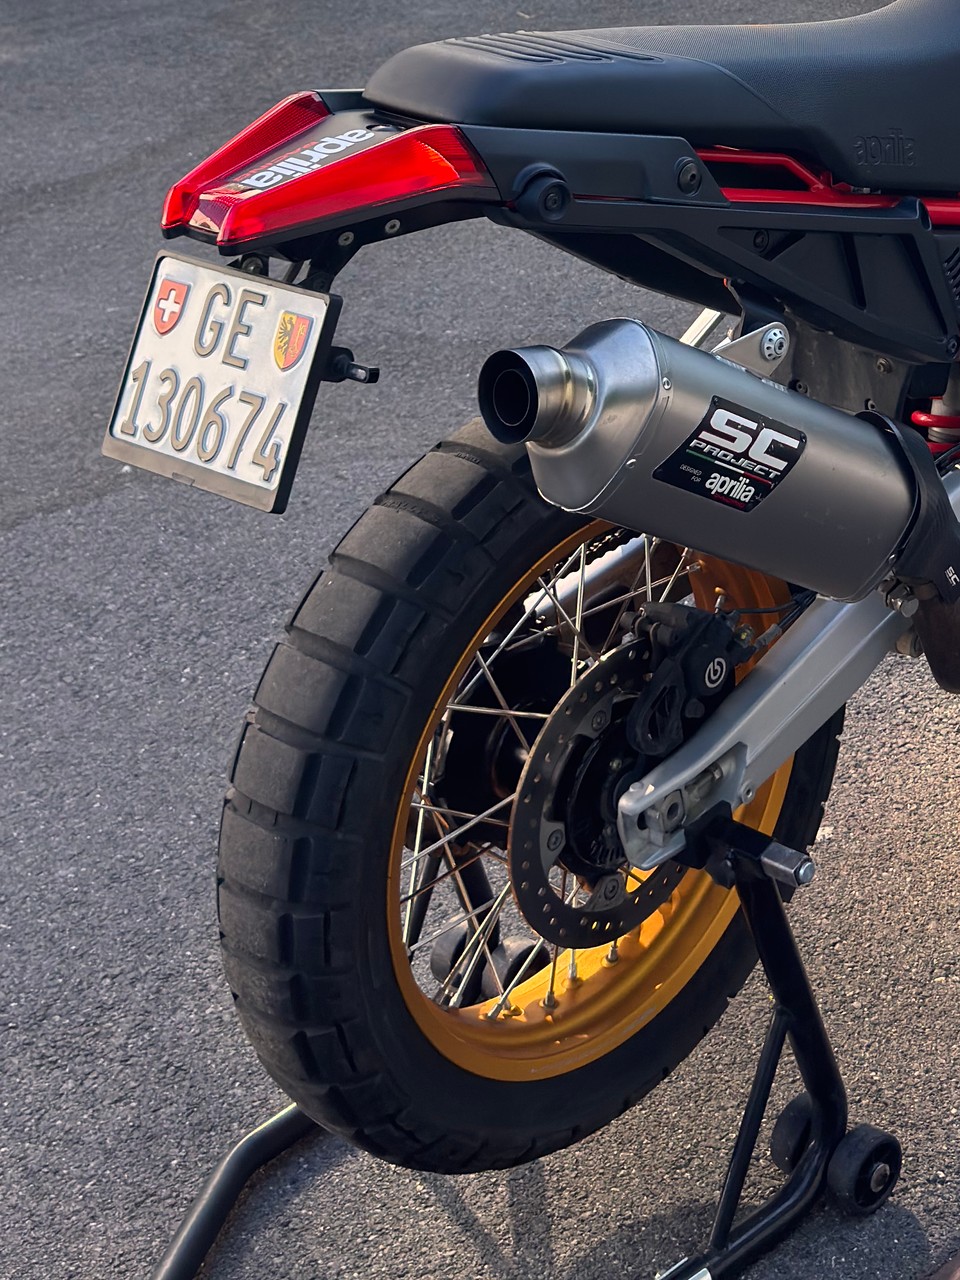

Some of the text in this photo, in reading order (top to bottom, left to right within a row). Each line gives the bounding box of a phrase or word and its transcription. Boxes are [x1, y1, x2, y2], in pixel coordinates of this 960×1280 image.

[240, 128, 375, 188] aprilia
[853, 127, 917, 167] aprilia
[193, 283, 267, 369] GE
[120, 360, 287, 482] 130674
[698, 408, 800, 471] SC
[679, 463, 702, 476] DESIGNED
[689, 439, 781, 479] PROJECT
[690, 475, 702, 483] FOR
[705, 472, 755, 503] aprilia
[946, 566, 960, 585] SC
